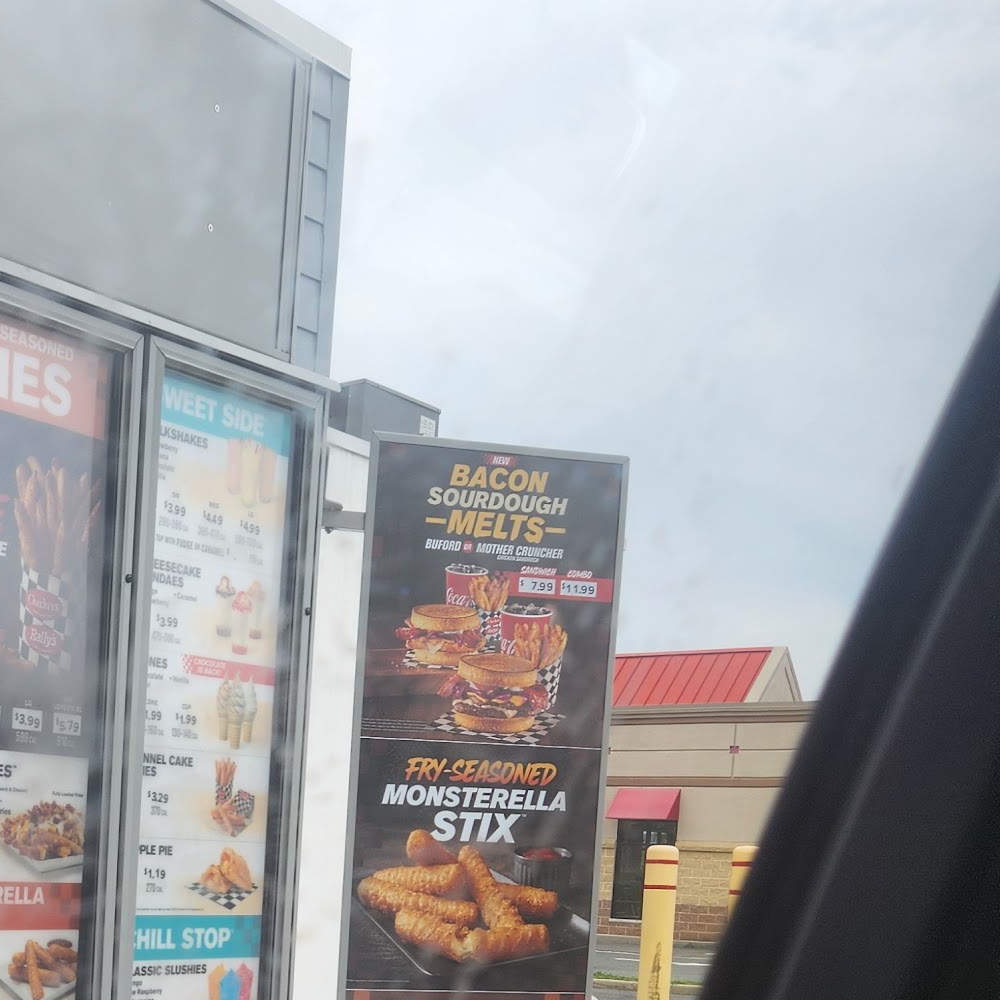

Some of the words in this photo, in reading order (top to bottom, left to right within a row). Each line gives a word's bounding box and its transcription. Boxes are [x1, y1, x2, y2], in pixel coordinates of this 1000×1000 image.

[0, 323, 74, 362] SEASONED
[222, 403, 265, 437] SIDE
[492, 456, 511, 465] NEW
[449, 464, 549, 493] BACON
[164, 500, 186, 517] $3.99
[427, 487, 568, 516] SOURDOUGH
[446, 509, 546, 544] MELTS
[425, 539, 462, 551] BUFORD
[476, 543, 514, 555] MOTHER
[515, 545, 564, 559] CRUNCHER
[520, 566, 556, 576] SANDWICH
[567, 570, 592, 579] COMBO
[562, 582, 595, 595] $11.99
[157, 613, 178, 628] $3.99
[15, 712, 41, 728] $3.99
[175, 712, 197, 726] $1.99
[168, 755, 193, 767] CAKE
[405, 757, 557, 786] FRY-SEASONED
[147, 790, 168, 804] $3.29
[381, 783, 566, 811] MONSTERELLA
[159, 845, 173, 856] PIE
[144, 868, 166, 879] $1.19
[182, 927, 231, 949] STOP
[164, 964, 207, 976] SLUSHIES
